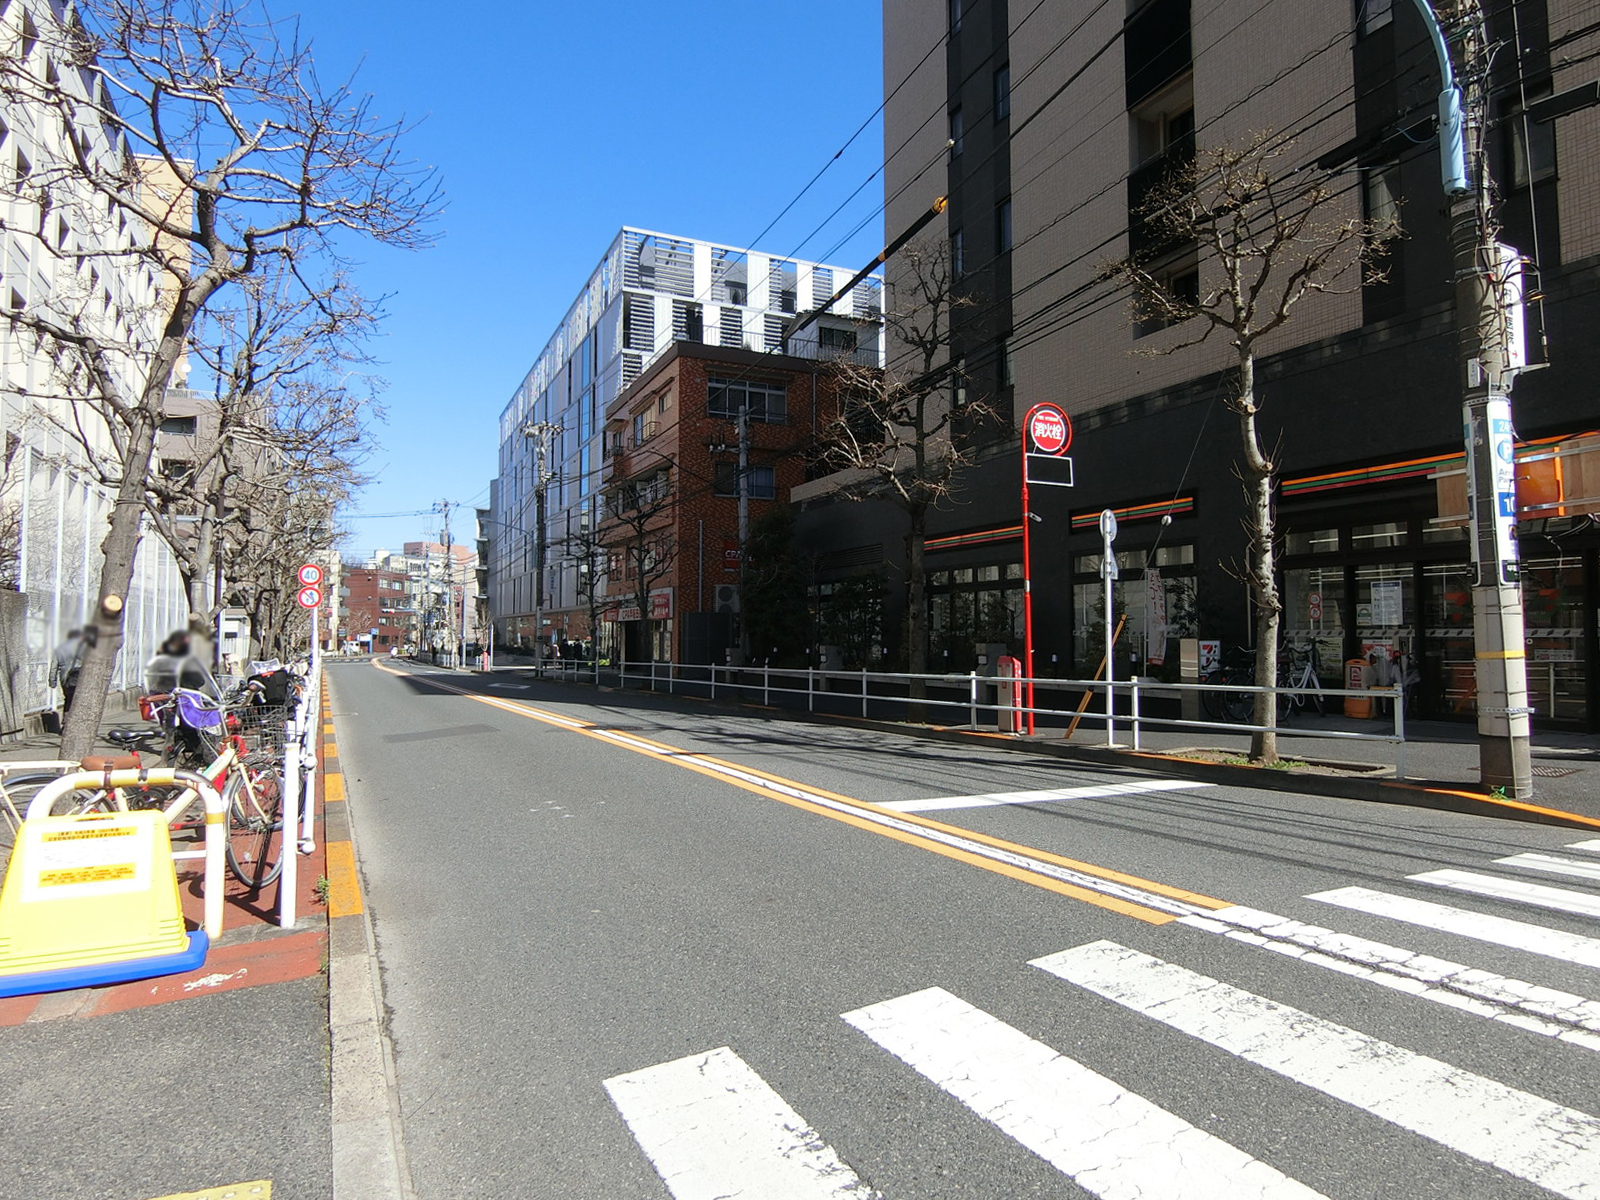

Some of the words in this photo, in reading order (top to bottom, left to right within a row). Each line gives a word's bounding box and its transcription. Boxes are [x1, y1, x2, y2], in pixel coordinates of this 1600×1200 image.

[1034, 421, 1062, 440] 消火栓
[304, 570, 318, 580] 40
